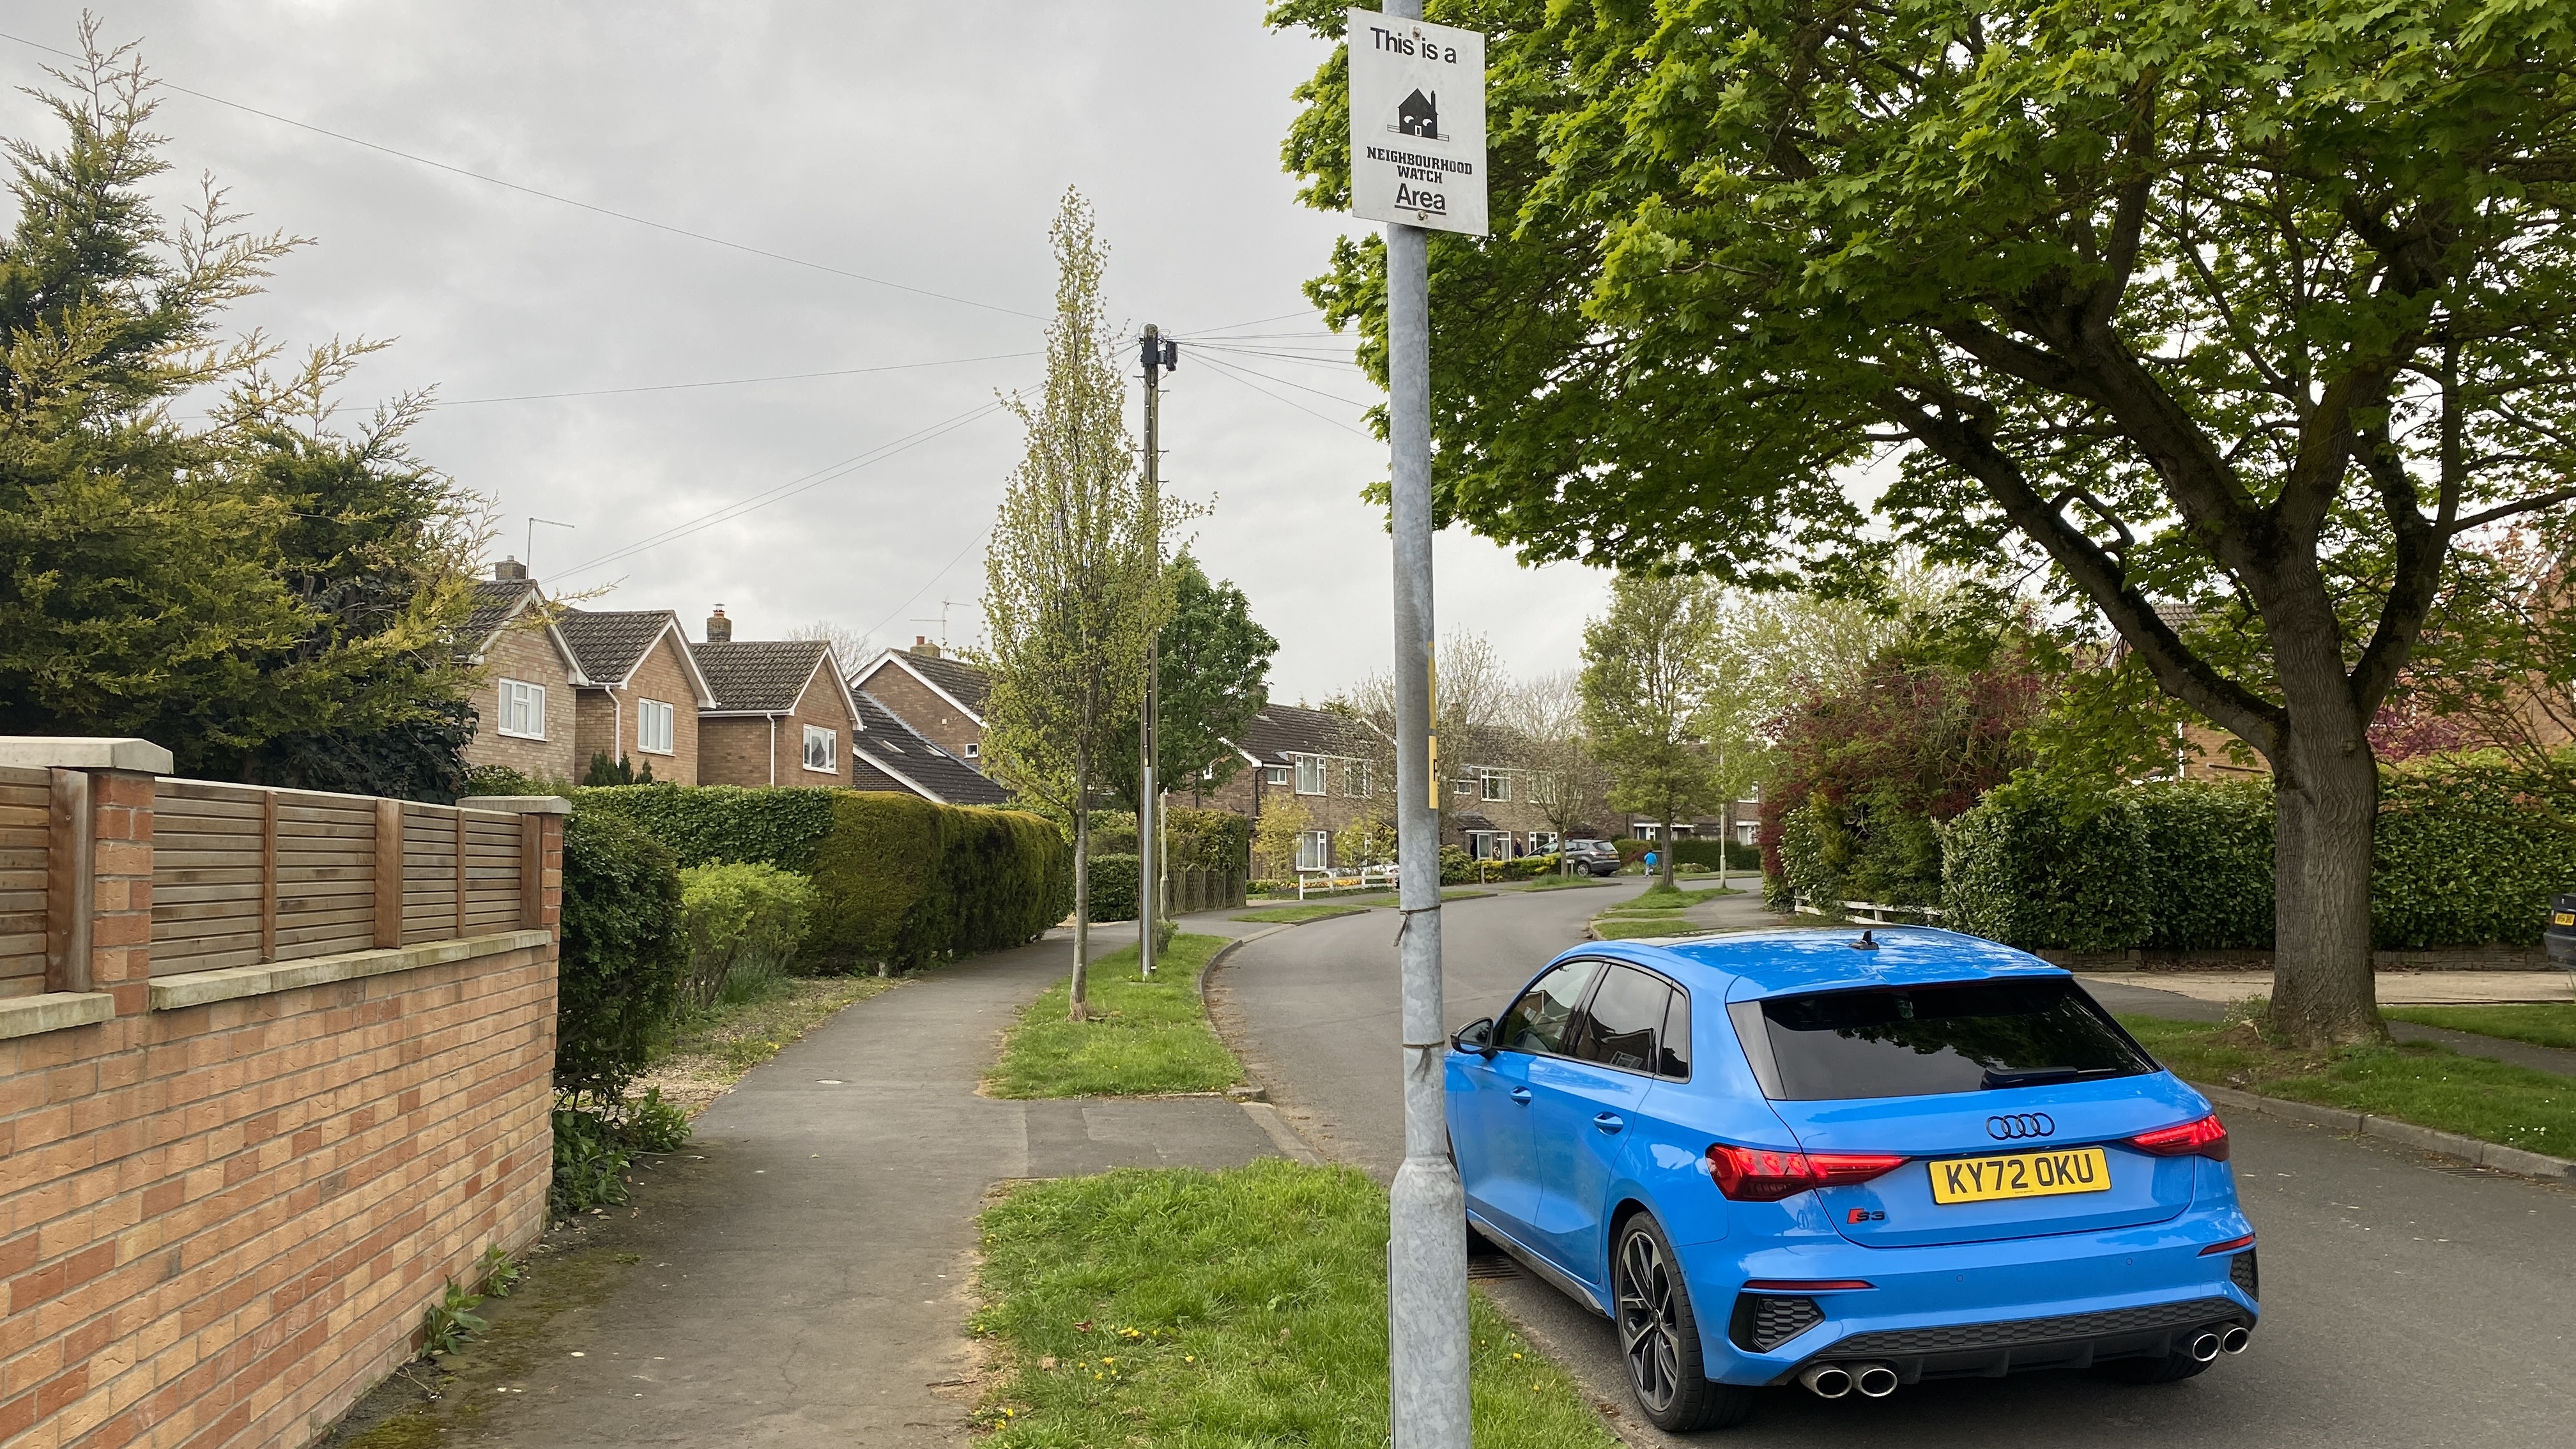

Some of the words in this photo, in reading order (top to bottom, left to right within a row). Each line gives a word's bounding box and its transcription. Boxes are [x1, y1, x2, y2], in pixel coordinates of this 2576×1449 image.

[1370, 26, 1414, 56] This
[1422, 38, 1438, 61] is
[1445, 47, 1457, 64] a
[1367, 146, 1472, 175] NEIGHBOURHOOD
[1397, 165, 1443, 184] WATCH
[1396, 183, 1446, 211] Area
[1945, 1159, 2028, 1194] KY72
[2034, 1153, 2094, 1186] OKU
[1856, 1211, 1885, 1221] S3
